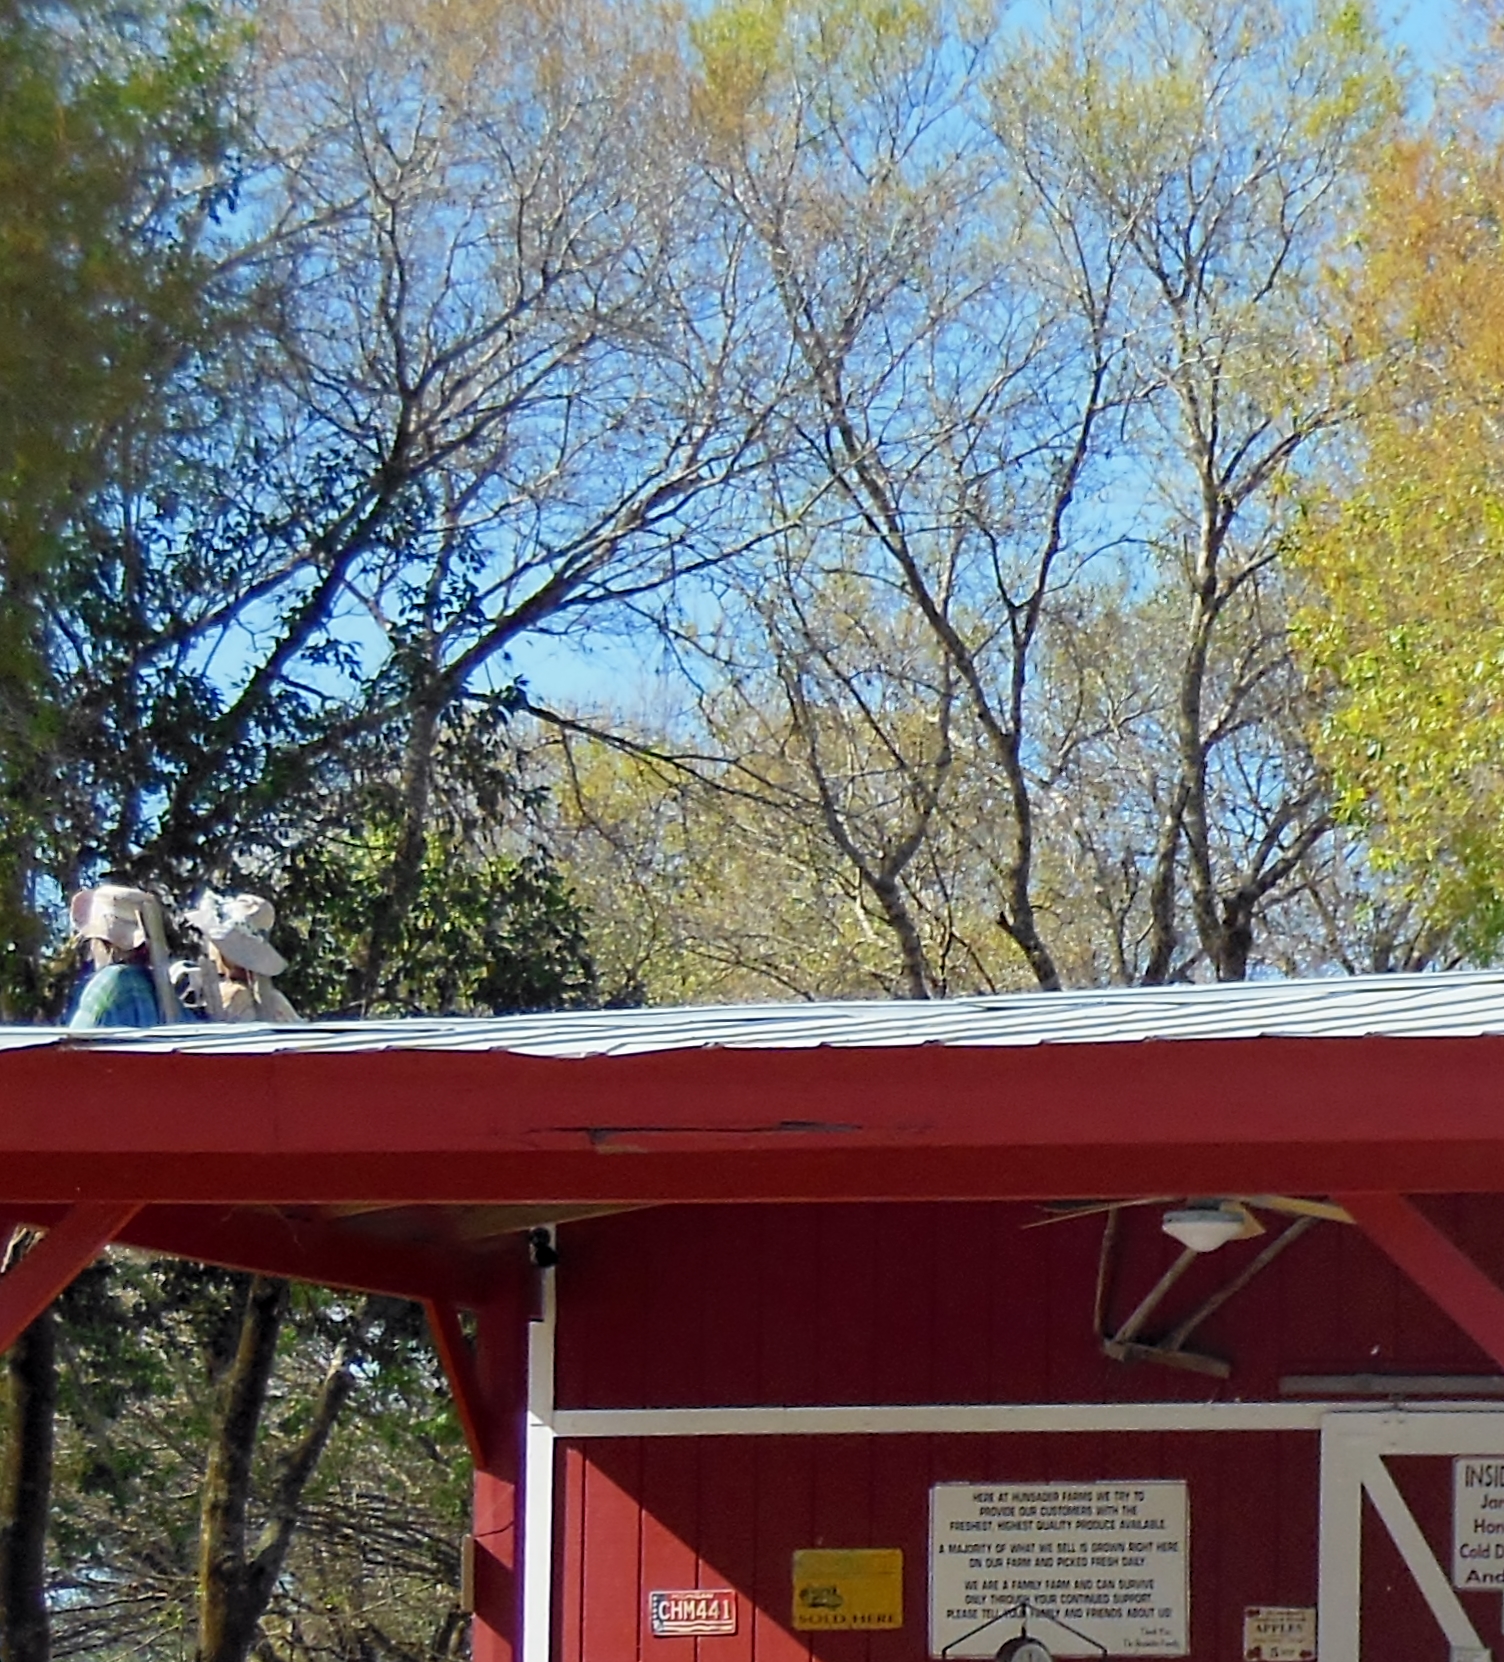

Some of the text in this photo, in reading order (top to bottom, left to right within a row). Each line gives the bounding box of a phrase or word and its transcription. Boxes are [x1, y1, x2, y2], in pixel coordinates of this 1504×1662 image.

[972, 1492, 995, 1503] HERE
[997, 1492, 1009, 1503] AT
[1062, 1491, 1093, 1503] FARMS
[1096, 1491, 1111, 1502] WE
[1114, 1490, 1131, 1501] TRY
[1133, 1490, 1145, 1502] TO
[979, 1505, 1138, 1517] PROVIDE OUR CUSTOMERS WITH THE
[997, 1520, 1034, 1531] HIGHEST
[1036, 1519, 1073, 1531] QUALITY
[1075, 1519, 1116, 1531] PRODUCE
[938, 1543, 945, 1554] A
[948, 1543, 992, 1554] MAJORITY
[994, 1543, 1007, 1554] OF
[1009, 1543, 1036, 1554] WHAT
[1038, 1543, 1053, 1554] WE
[1056, 1542, 1077, 1554] SELL
[1080, 1542, 1088, 1554] IS
[1091, 1542, 1126, 1554] GROWN
[1128, 1541, 1154, 1553] RIGHT
[1460, 1543, 1491, 1559] Cold
[968, 1557, 983, 1569] ON
[985, 1557, 1004, 1568] OUR
[1006, 1557, 1032, 1568] FARM
[1034, 1557, 1054, 1568] AND
[1056, 1557, 1088, 1568] PICKED
[1090, 1556, 1120, 1568] FRESH
[964, 1578, 1155, 1591] WE ARE A FAMILY FARM AND CAN SURVIVE
[964, 1594, 988, 1605] ONLY
[1034, 1594, 1058, 1605] YOUR
[1060, 1593, 1111, 1605] CONTINUED
[658, 1599, 731, 1621] CHM441
[946, 1609, 978, 1620] PLEASE
[1063, 1608, 1084, 1619] AND
[1086, 1608, 1123, 1619] FRIENDS
[1126, 1607, 1156, 1619] ABOUT
[852, 1613, 897, 1624] HERE
